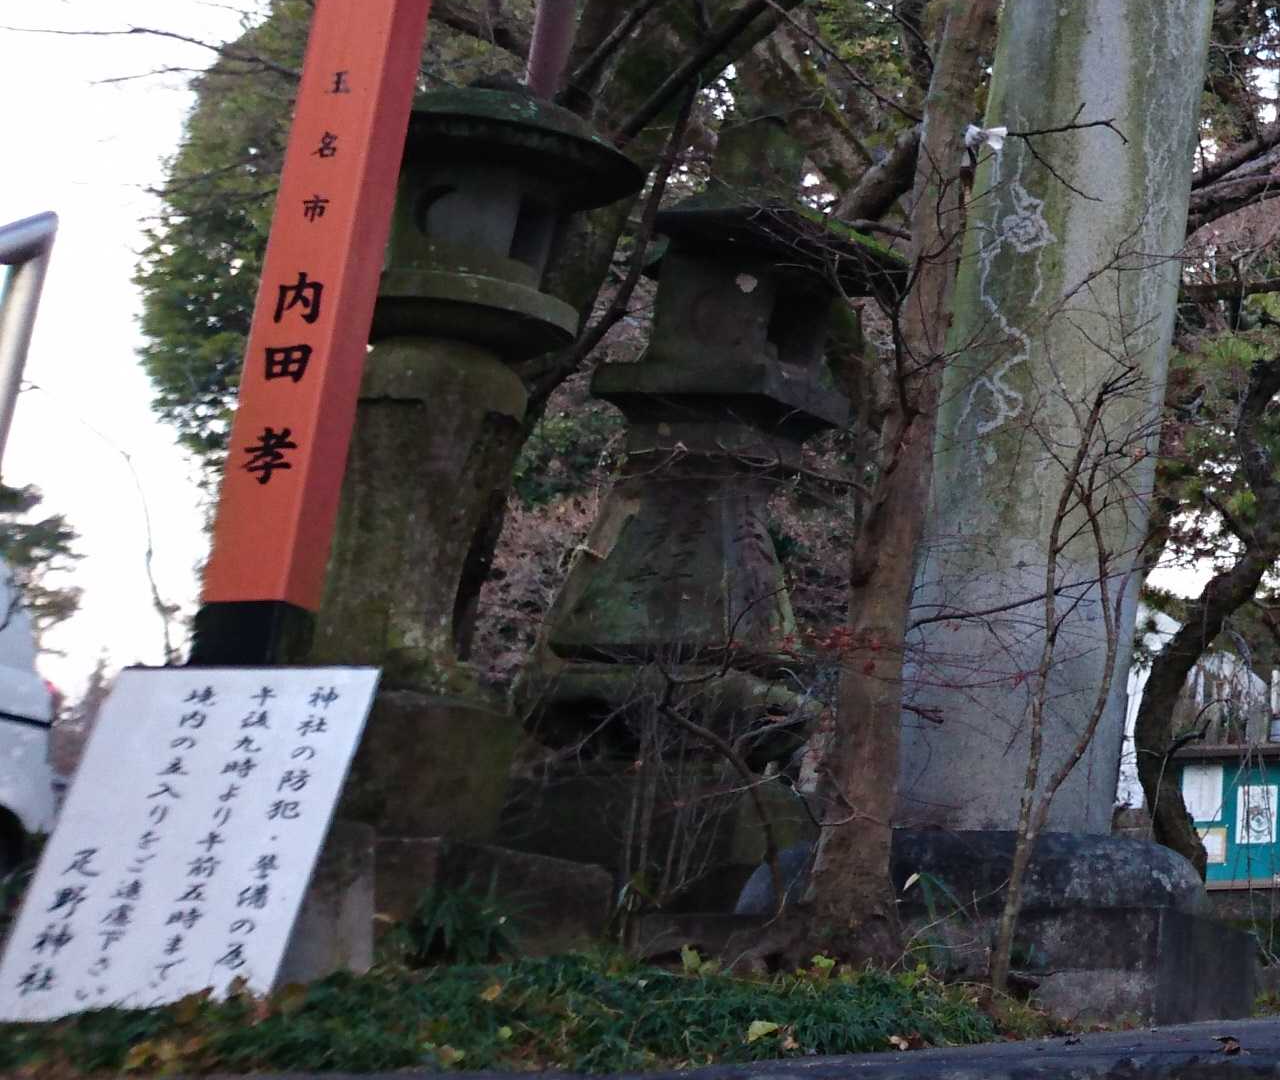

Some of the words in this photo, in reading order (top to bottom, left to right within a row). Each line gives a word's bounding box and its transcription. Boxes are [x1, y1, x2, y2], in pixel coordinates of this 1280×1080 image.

[301, 69, 351, 223] 玉名市
[241, 271, 324, 485] 内田孝
